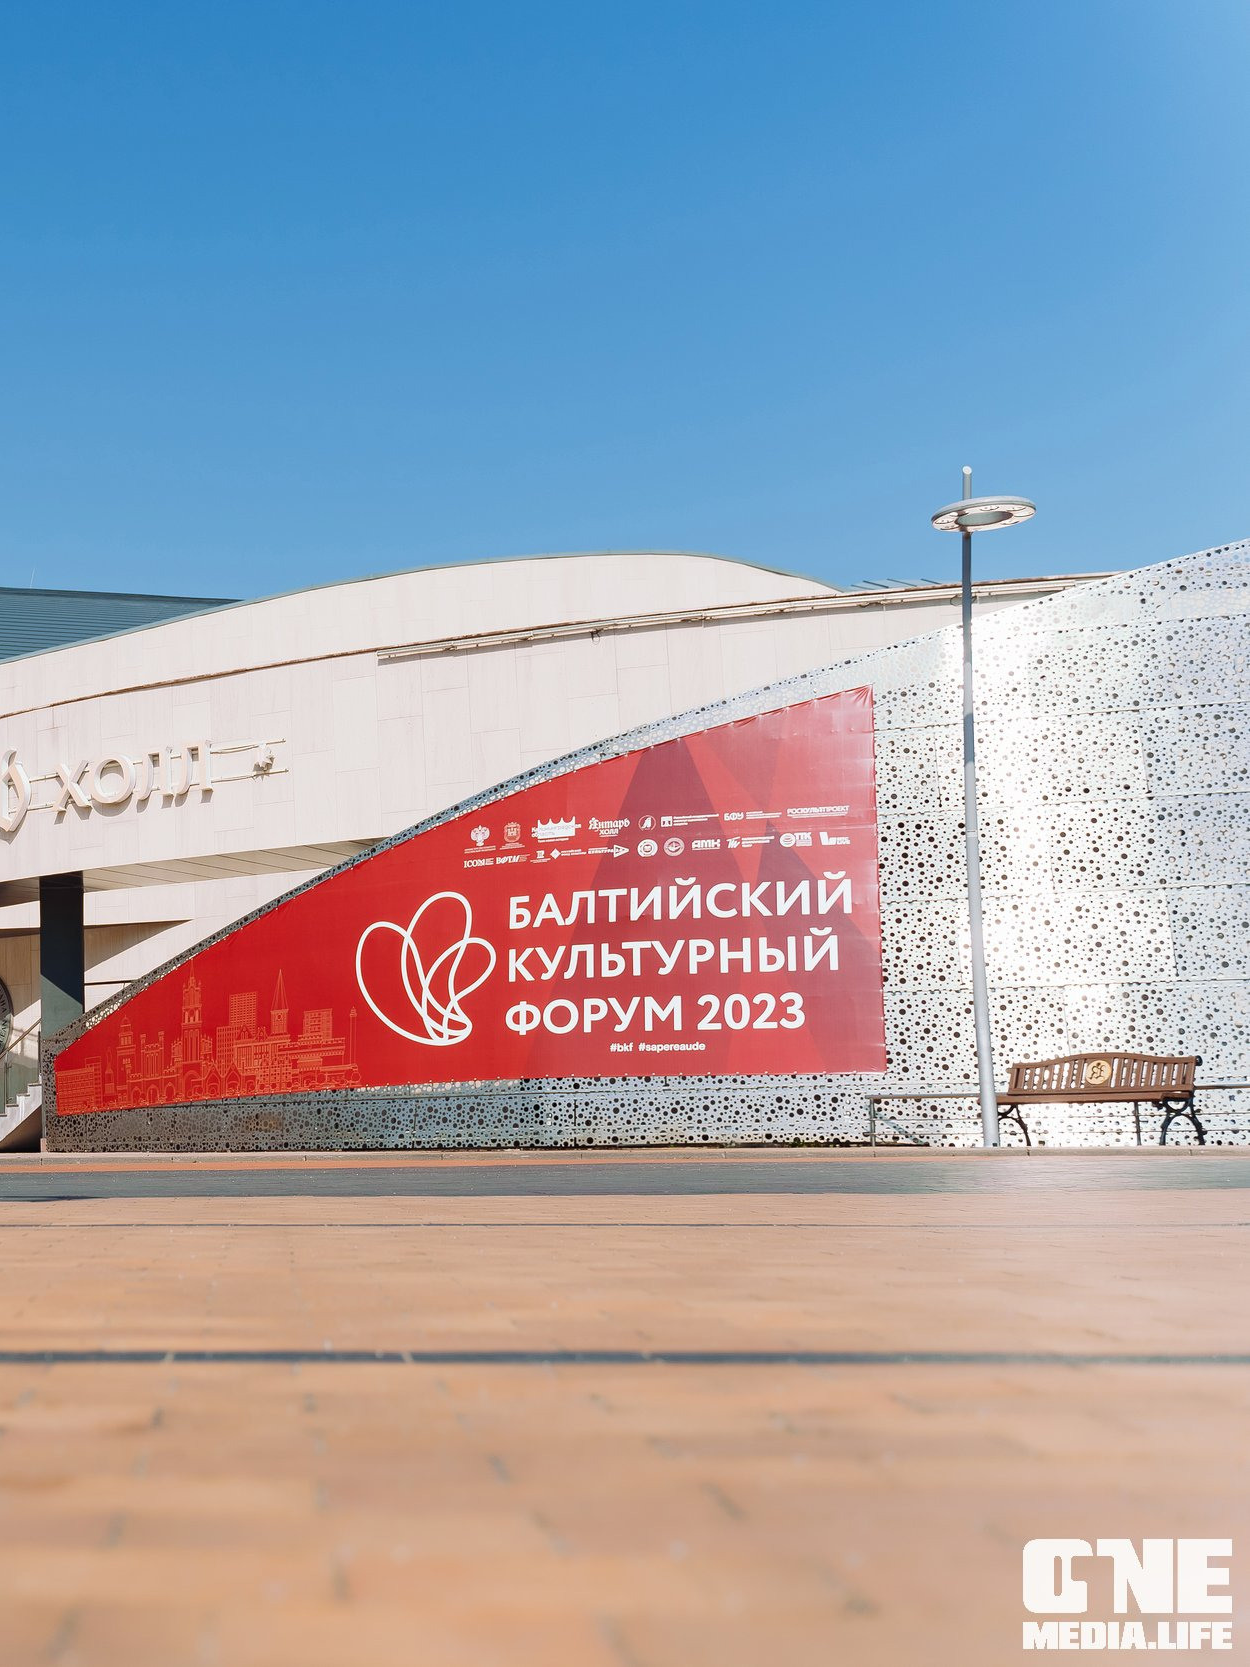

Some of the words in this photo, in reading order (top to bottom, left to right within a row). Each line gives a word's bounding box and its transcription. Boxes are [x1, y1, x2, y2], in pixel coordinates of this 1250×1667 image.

[509, 871, 853, 930] БАЛТИЙСКИЙ
[508, 926, 839, 982] КУЛЬТУРНЫЙ
[505, 996, 682, 1036] ФОРУМ
[697, 992, 806, 1031] 2023
[609, 1042, 634, 1053] #bkf
[638, 1041, 706, 1054] #sapereaude
